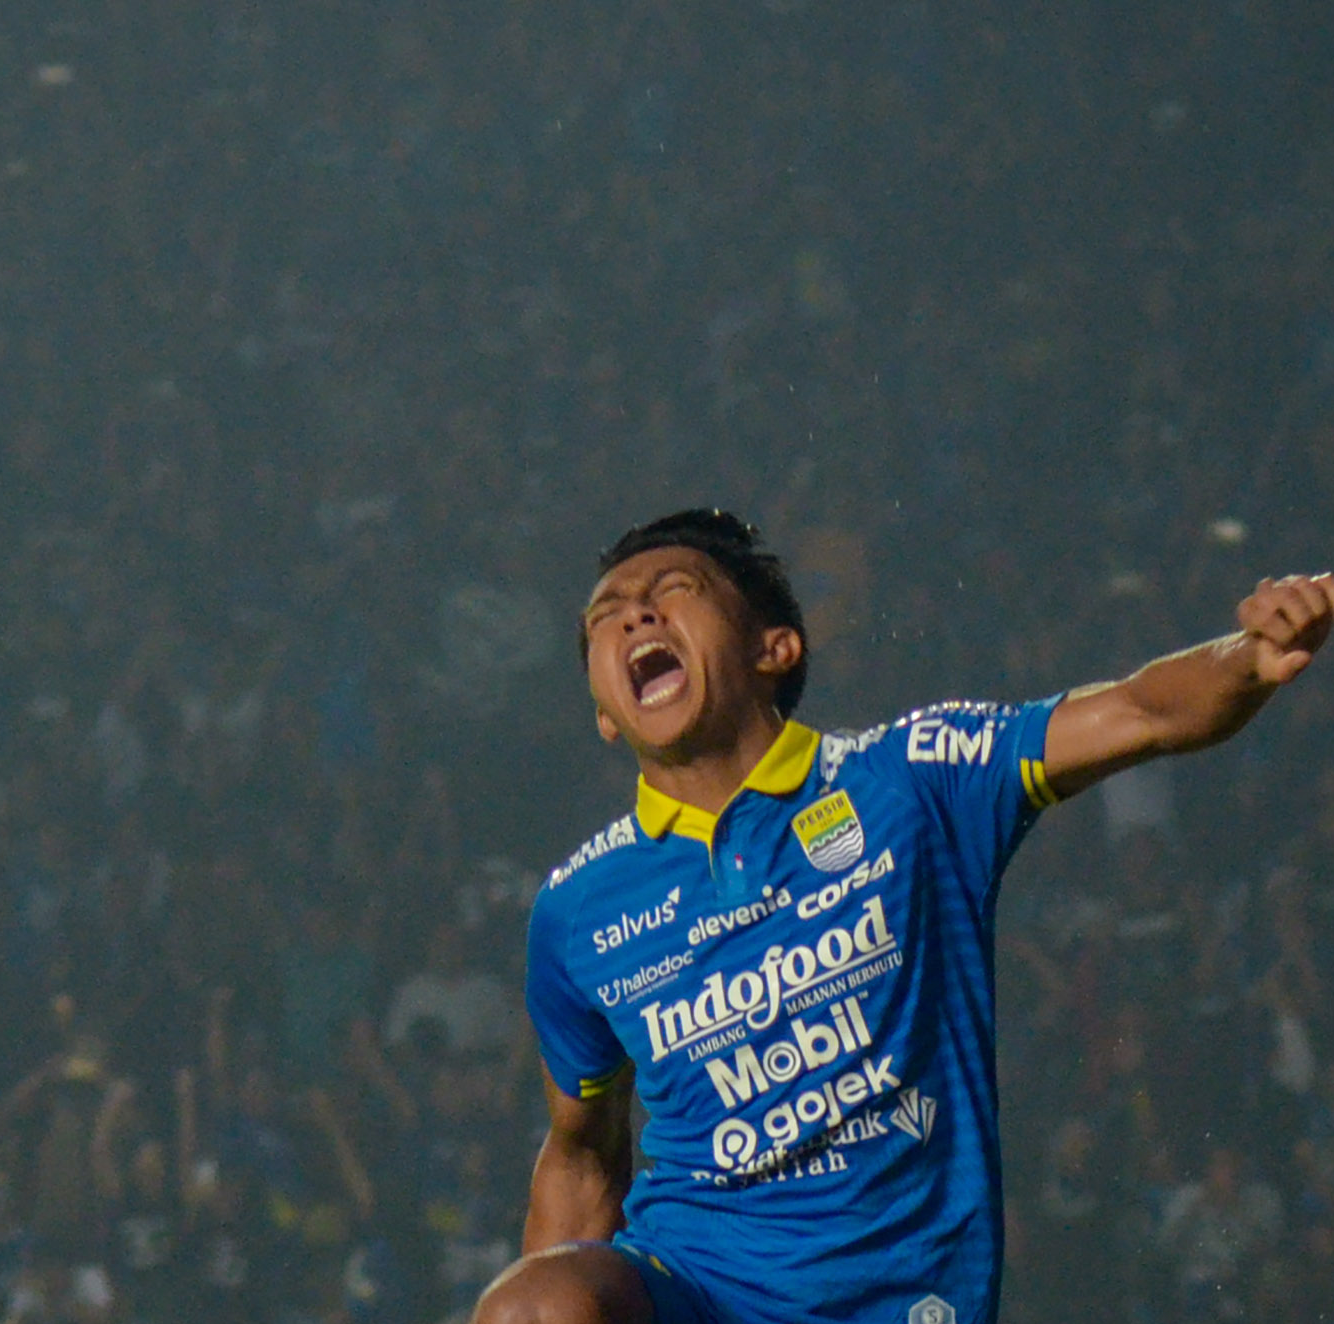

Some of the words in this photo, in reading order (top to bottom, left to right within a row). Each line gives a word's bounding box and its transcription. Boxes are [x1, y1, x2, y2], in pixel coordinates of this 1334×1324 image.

[797, 797, 845, 832] PERSIB
[592, 898, 676, 955] salvus
[687, 884, 793, 946] elevenia
[621, 949, 694, 998] halodoc
[639, 894, 895, 1064] Indofood
[687, 1025, 747, 1063] LAMBANG
[784, 976, 848, 1017] MAKANAN
[846, 950, 904, 990] BERMUTU
[704, 996, 873, 1110] Mobil
[763, 1053, 902, 1146] gojek
